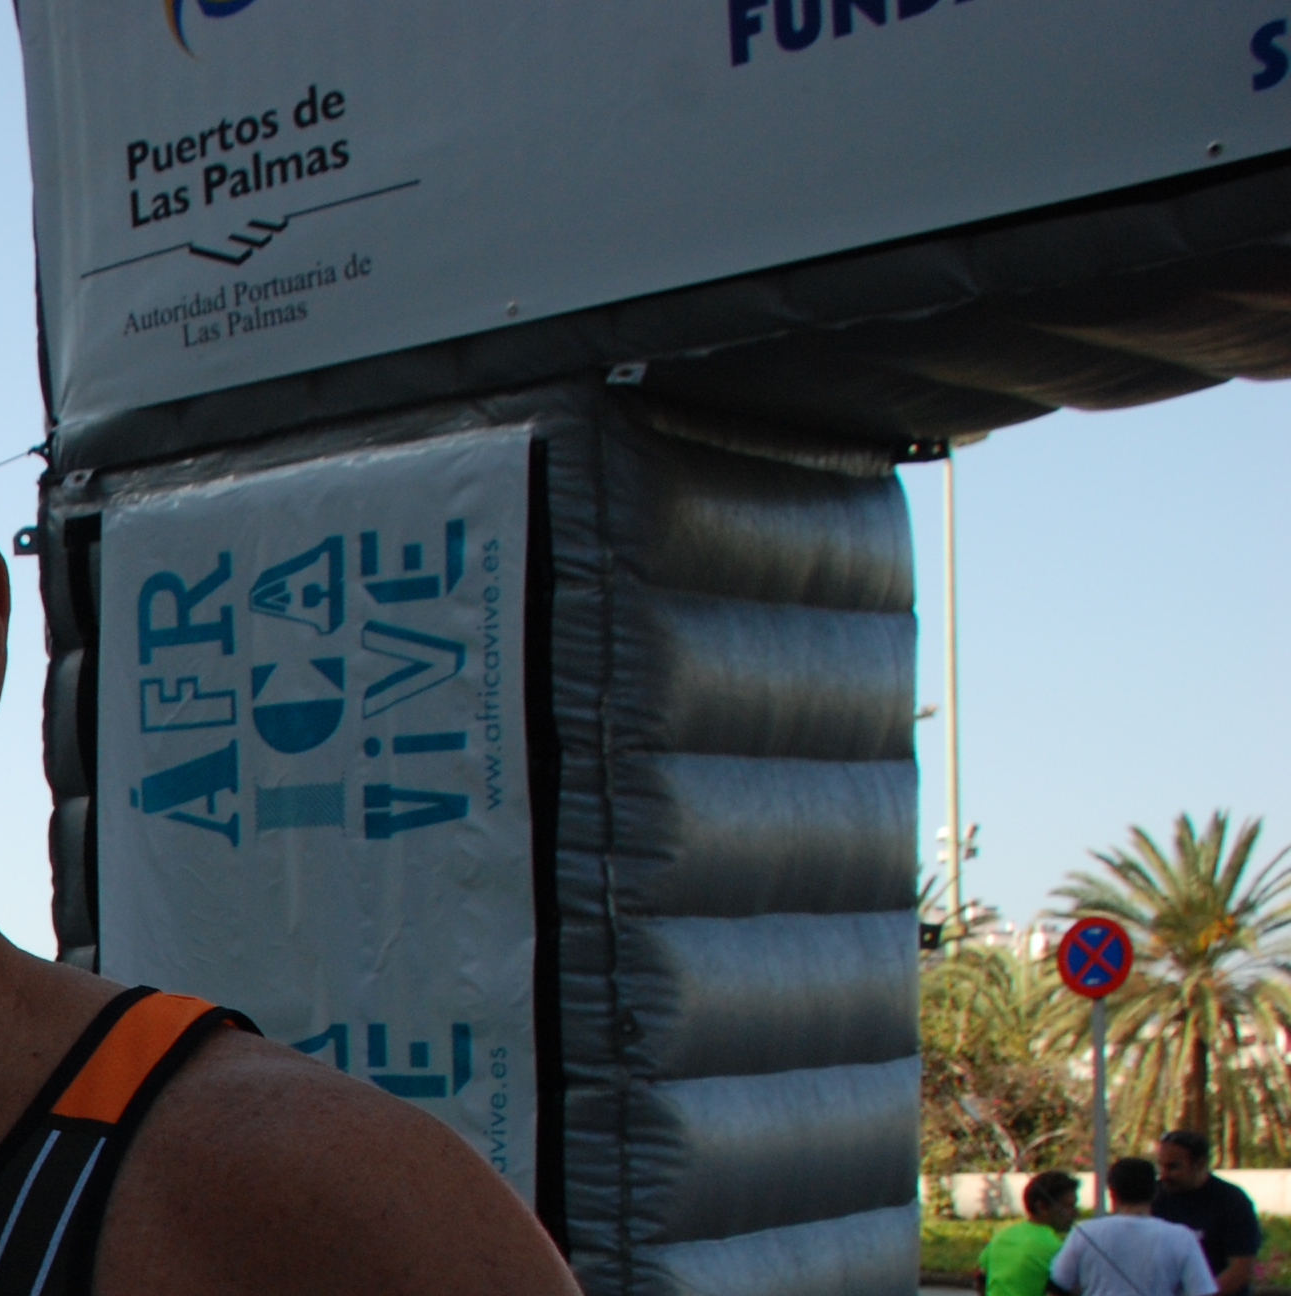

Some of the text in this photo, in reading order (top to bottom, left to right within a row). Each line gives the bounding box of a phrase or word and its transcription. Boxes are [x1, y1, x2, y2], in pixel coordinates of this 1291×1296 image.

[127, 83, 346, 181] Puertos de
[130, 138, 350, 228] Las Palmas
[123, 253, 373, 335] Autoridad Portuaria de
[182, 300, 308, 348] Las Palmas
[130, 551, 240, 847] ÁFR
[249, 535, 345, 836] ICA
